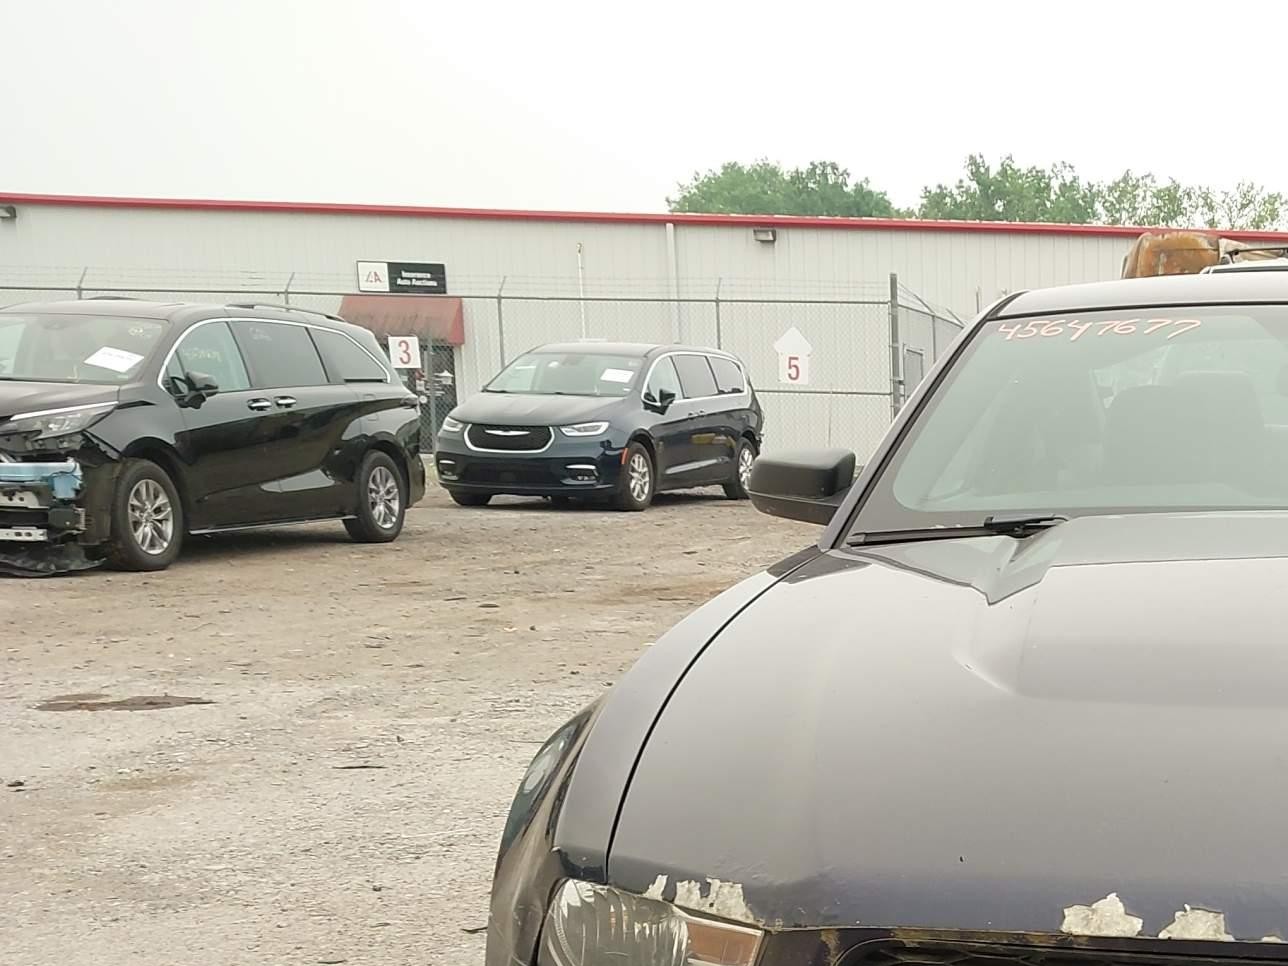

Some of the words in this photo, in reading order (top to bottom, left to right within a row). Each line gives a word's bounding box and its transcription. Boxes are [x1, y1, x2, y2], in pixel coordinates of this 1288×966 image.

[1000, 319, 1201, 341] 45647677
[399, 340, 411, 365] 3
[788, 356, 800, 381] 5
